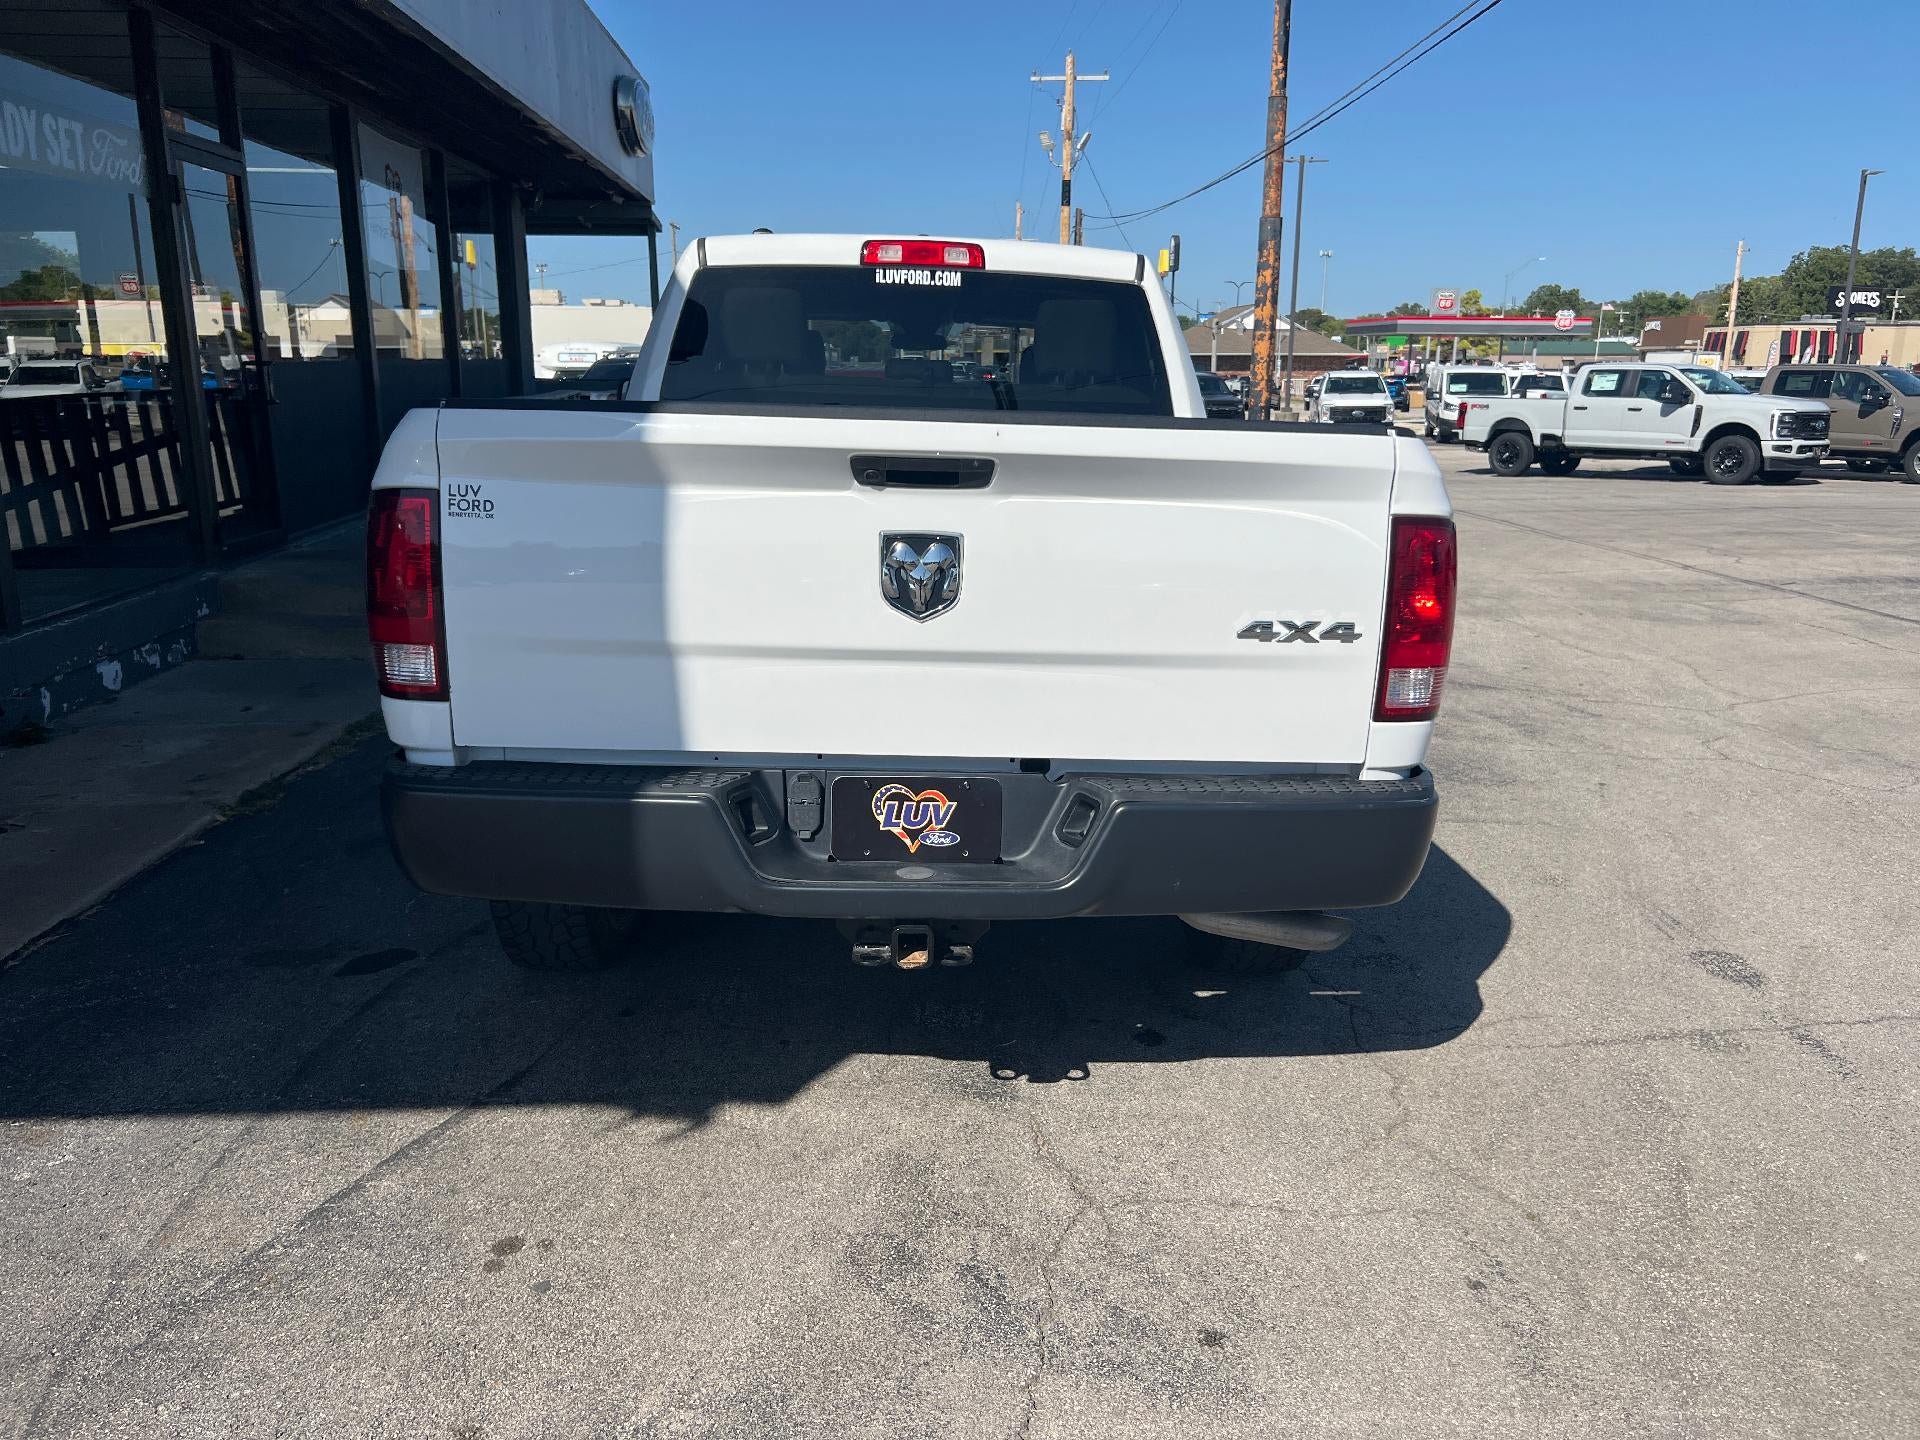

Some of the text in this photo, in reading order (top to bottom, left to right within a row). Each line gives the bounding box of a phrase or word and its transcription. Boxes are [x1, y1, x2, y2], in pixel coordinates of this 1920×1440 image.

[42, 112, 85, 173] SET
[89, 128, 145, 184] Ford
[875, 268, 962, 287] iLUVFORD.COM
[1835, 291, 1881, 308] SONEYS
[448, 484, 481, 498] LUV
[448, 498, 494, 512] FORD
[1236, 620, 1363, 643] 4X4
[880, 800, 957, 830] LUV
[926, 832, 952, 845] Ford
